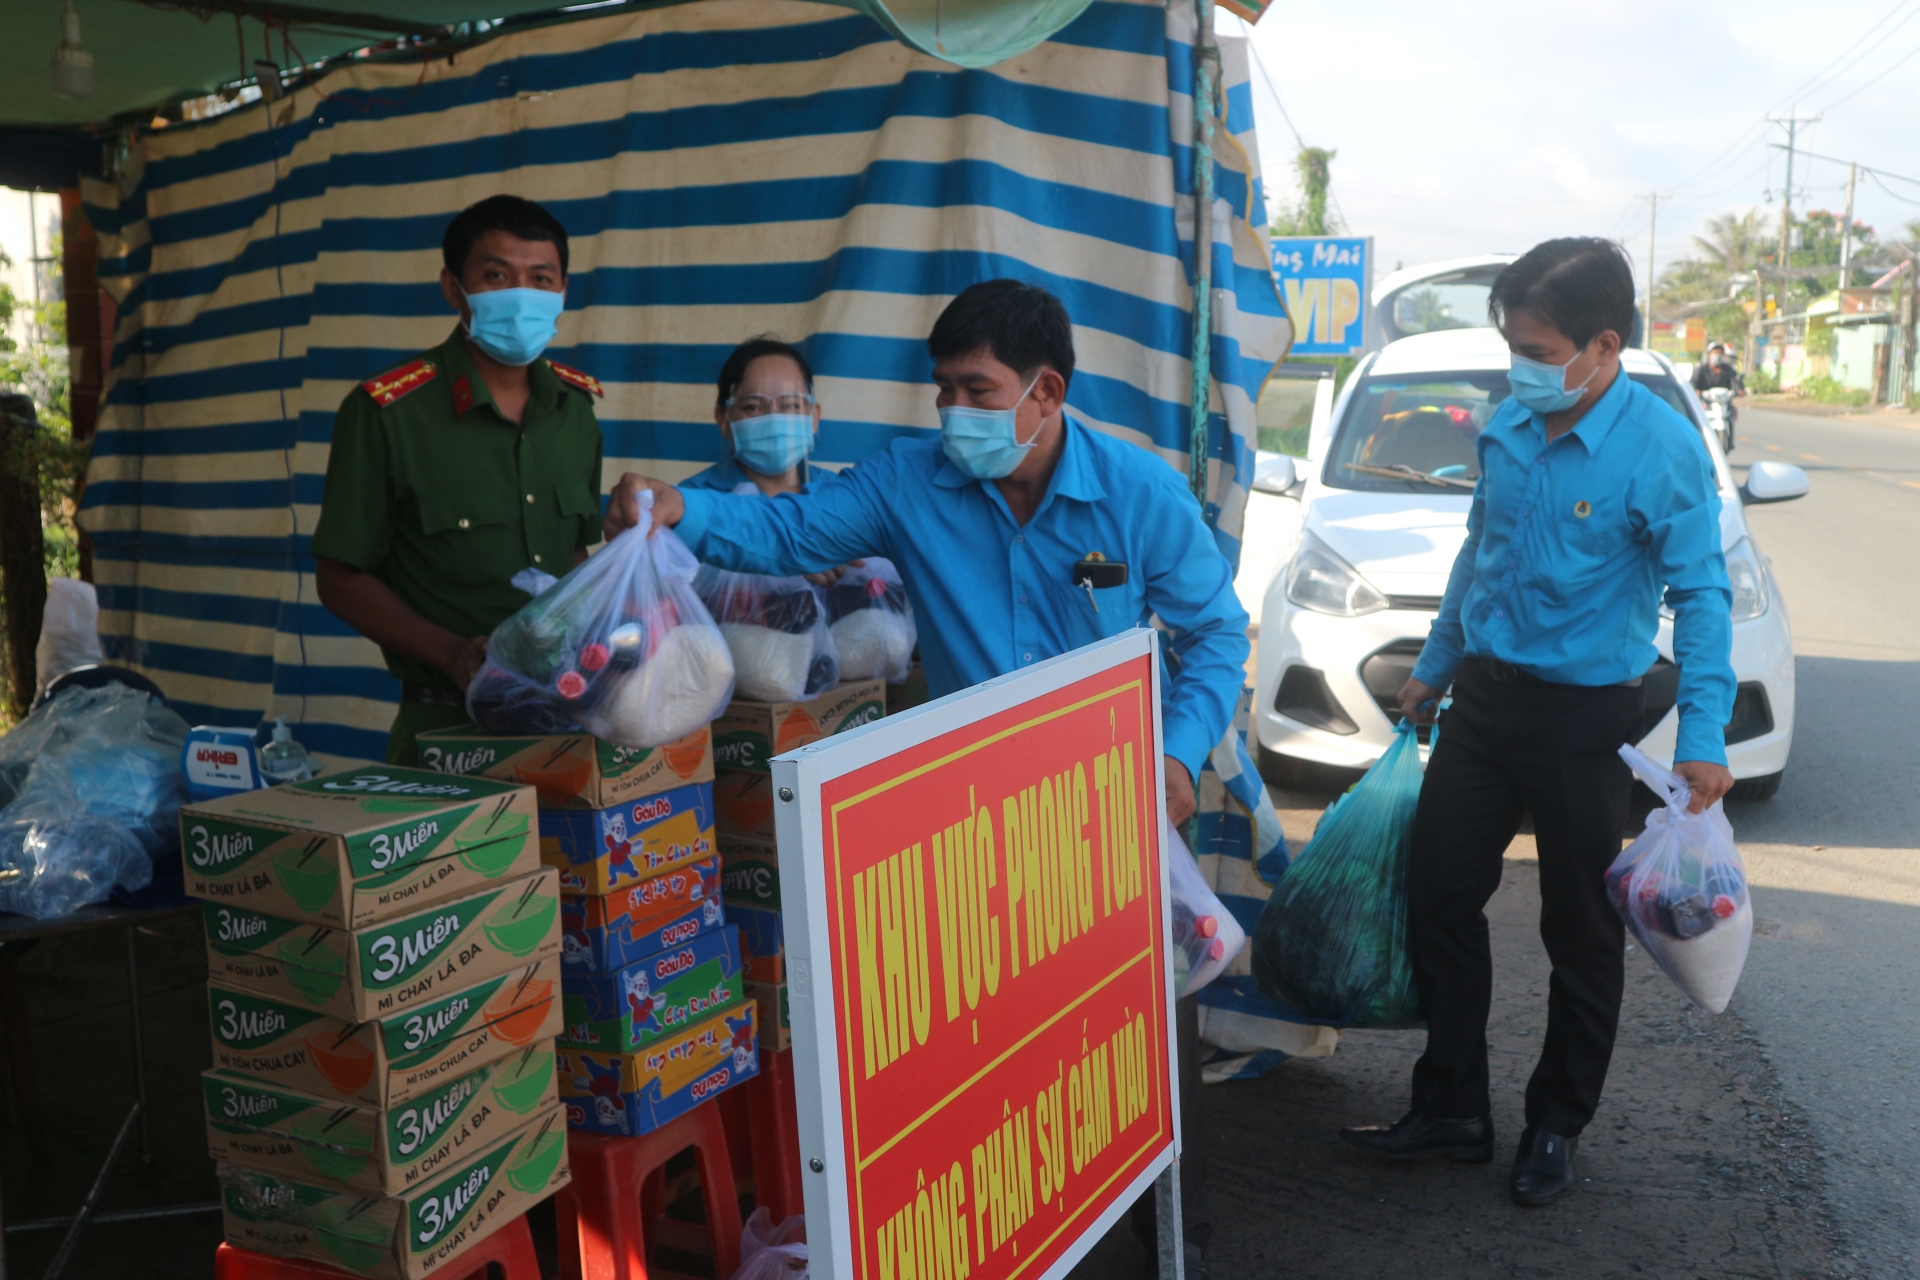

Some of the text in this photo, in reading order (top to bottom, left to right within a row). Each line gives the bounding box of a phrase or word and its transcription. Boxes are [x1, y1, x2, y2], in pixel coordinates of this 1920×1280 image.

[1312, 242, 1361, 267] Mai
[1284, 278, 1360, 344] VIP
[650, 759, 663, 775] CAY
[643, 835, 710, 872] Tôm Chua Cay
[210, 882, 234, 896] CHAY
[237, 876, 252, 895] LÁ
[253, 872, 272, 890] ĐA
[379, 864, 455, 905] MÌ CHAY LÁ ĐA
[853, 706, 1142, 1081] KHU VỰC PHONG TỎA
[235, 966, 254, 977] CHAY
[378, 943, 482, 1010] MÌ CHAY LÁ ĐA
[231, 1056, 251, 1069] TÔM
[252, 1058, 284, 1070] CHUA
[284, 1050, 306, 1068] CAY
[406, 1031, 488, 1085] MÌ TÔM CHUA CAY
[645, 1053, 665, 1072] Cay
[241, 1143, 263, 1154] CHAY
[405, 1106, 492, 1183] MÌ CHAY LÁ ĐA
[972, 1098, 1034, 1266] PHẬN
[1036, 1060, 1066, 1211] SỰ
[1068, 1018, 1113, 1176] CẤM
[1112, 1007, 1148, 1132] VÀO
[423, 1253, 436, 1270] MÌ
[438, 1228, 466, 1258] CHAY
[487, 1189, 505, 1212] ĐA
